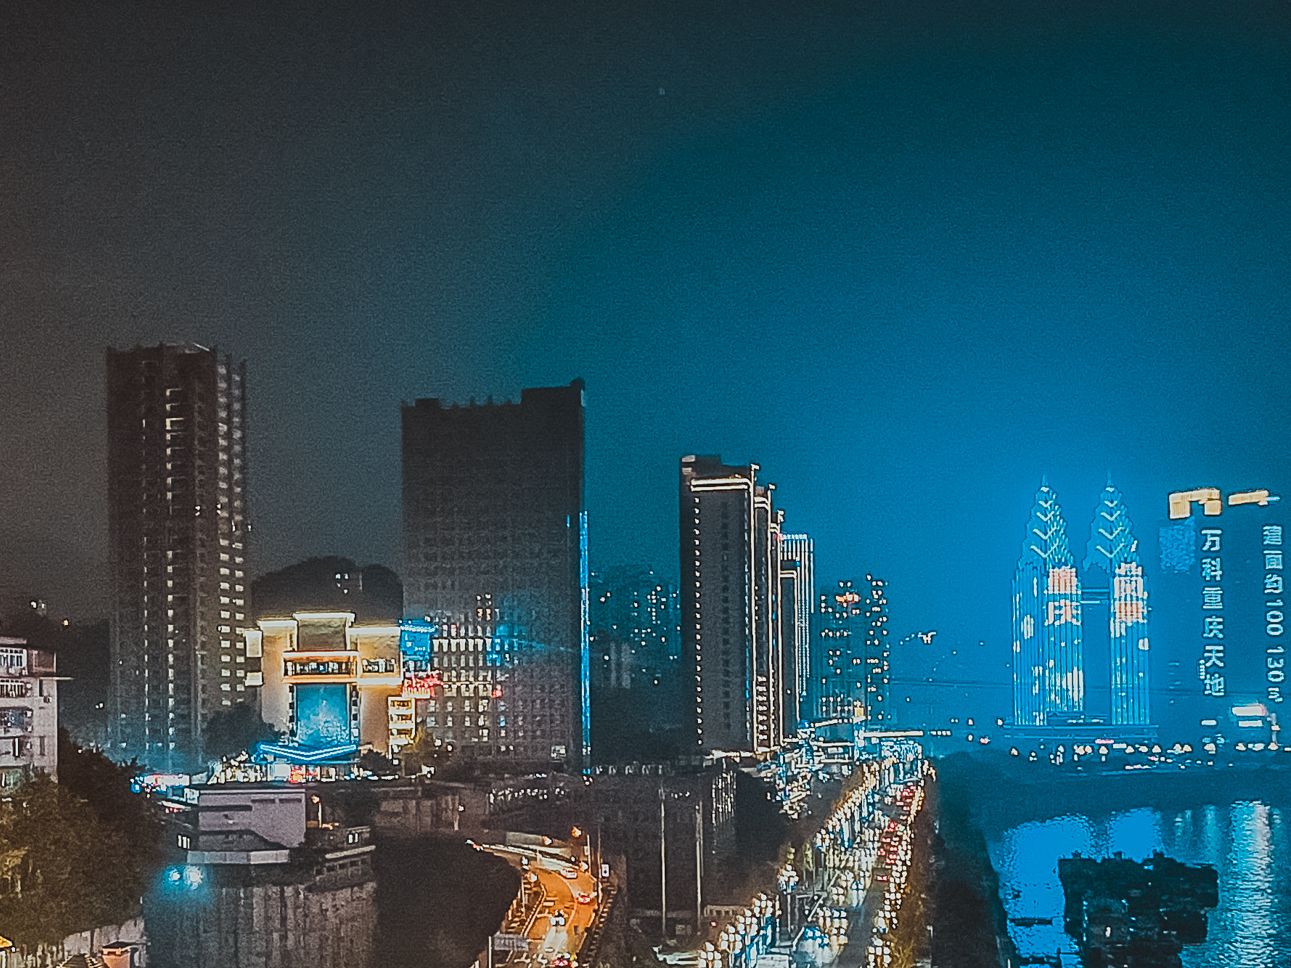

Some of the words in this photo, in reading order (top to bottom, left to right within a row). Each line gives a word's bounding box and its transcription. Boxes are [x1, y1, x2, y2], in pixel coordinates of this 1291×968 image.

[1201, 529, 1224, 696] 万科重庆天地
